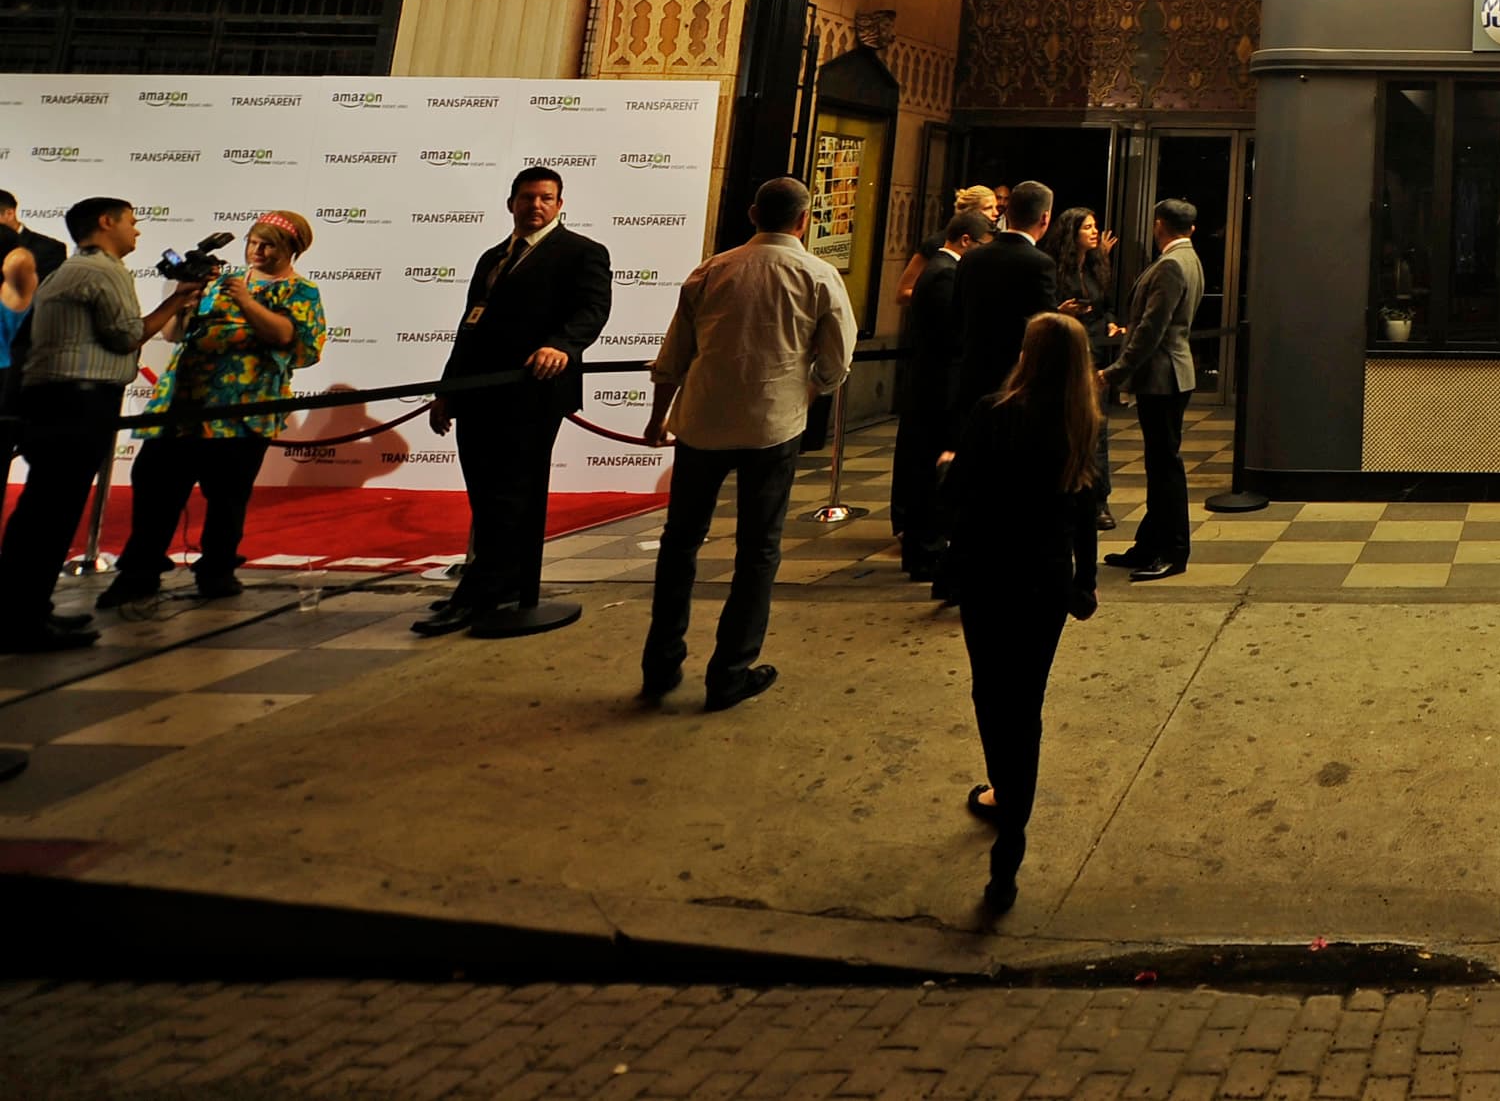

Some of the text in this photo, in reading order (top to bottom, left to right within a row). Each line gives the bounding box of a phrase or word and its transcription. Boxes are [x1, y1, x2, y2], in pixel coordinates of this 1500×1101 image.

[40, 95, 110, 105] TRANSPARENT
[138, 90, 188, 102] amazon
[332, 92, 383, 103] amazon
[530, 96, 581, 106] amazon
[231, 97, 302, 107] TRANSPARENT
[427, 98, 500, 108] TRANSPARENT
[626, 101, 699, 111] TRANSPARENT
[31, 146, 80, 157] amazon
[223, 149, 273, 159] amazon
[420, 150, 471, 160] amazon
[129, 152, 201, 163] TRANSPARENT
[324, 154, 397, 164] TRANSPARENT
[523, 157, 597, 167] TRANSPARENT
[620, 153, 671, 163] amazon
[21, 209, 65, 219] TRANSPA
[132, 206, 170, 216] azon
[316, 207, 367, 218] amazon
[213, 212, 264, 221] TRANSPA
[411, 213, 485, 223] TRANSPARENT
[612, 216, 687, 226] TRANSPARENT
[308, 270, 382, 280] TRANSPARENT
[404, 267, 456, 277] amazon
[611, 270, 658, 280] mazon
[396, 332, 456, 342] TRANSPARE
[600, 335, 664, 345] TRANSPARE
[594, 390, 647, 401] amazon
[381, 453, 456, 464] TRANSPARENT
[586, 456, 664, 466] TRANSPARENT
